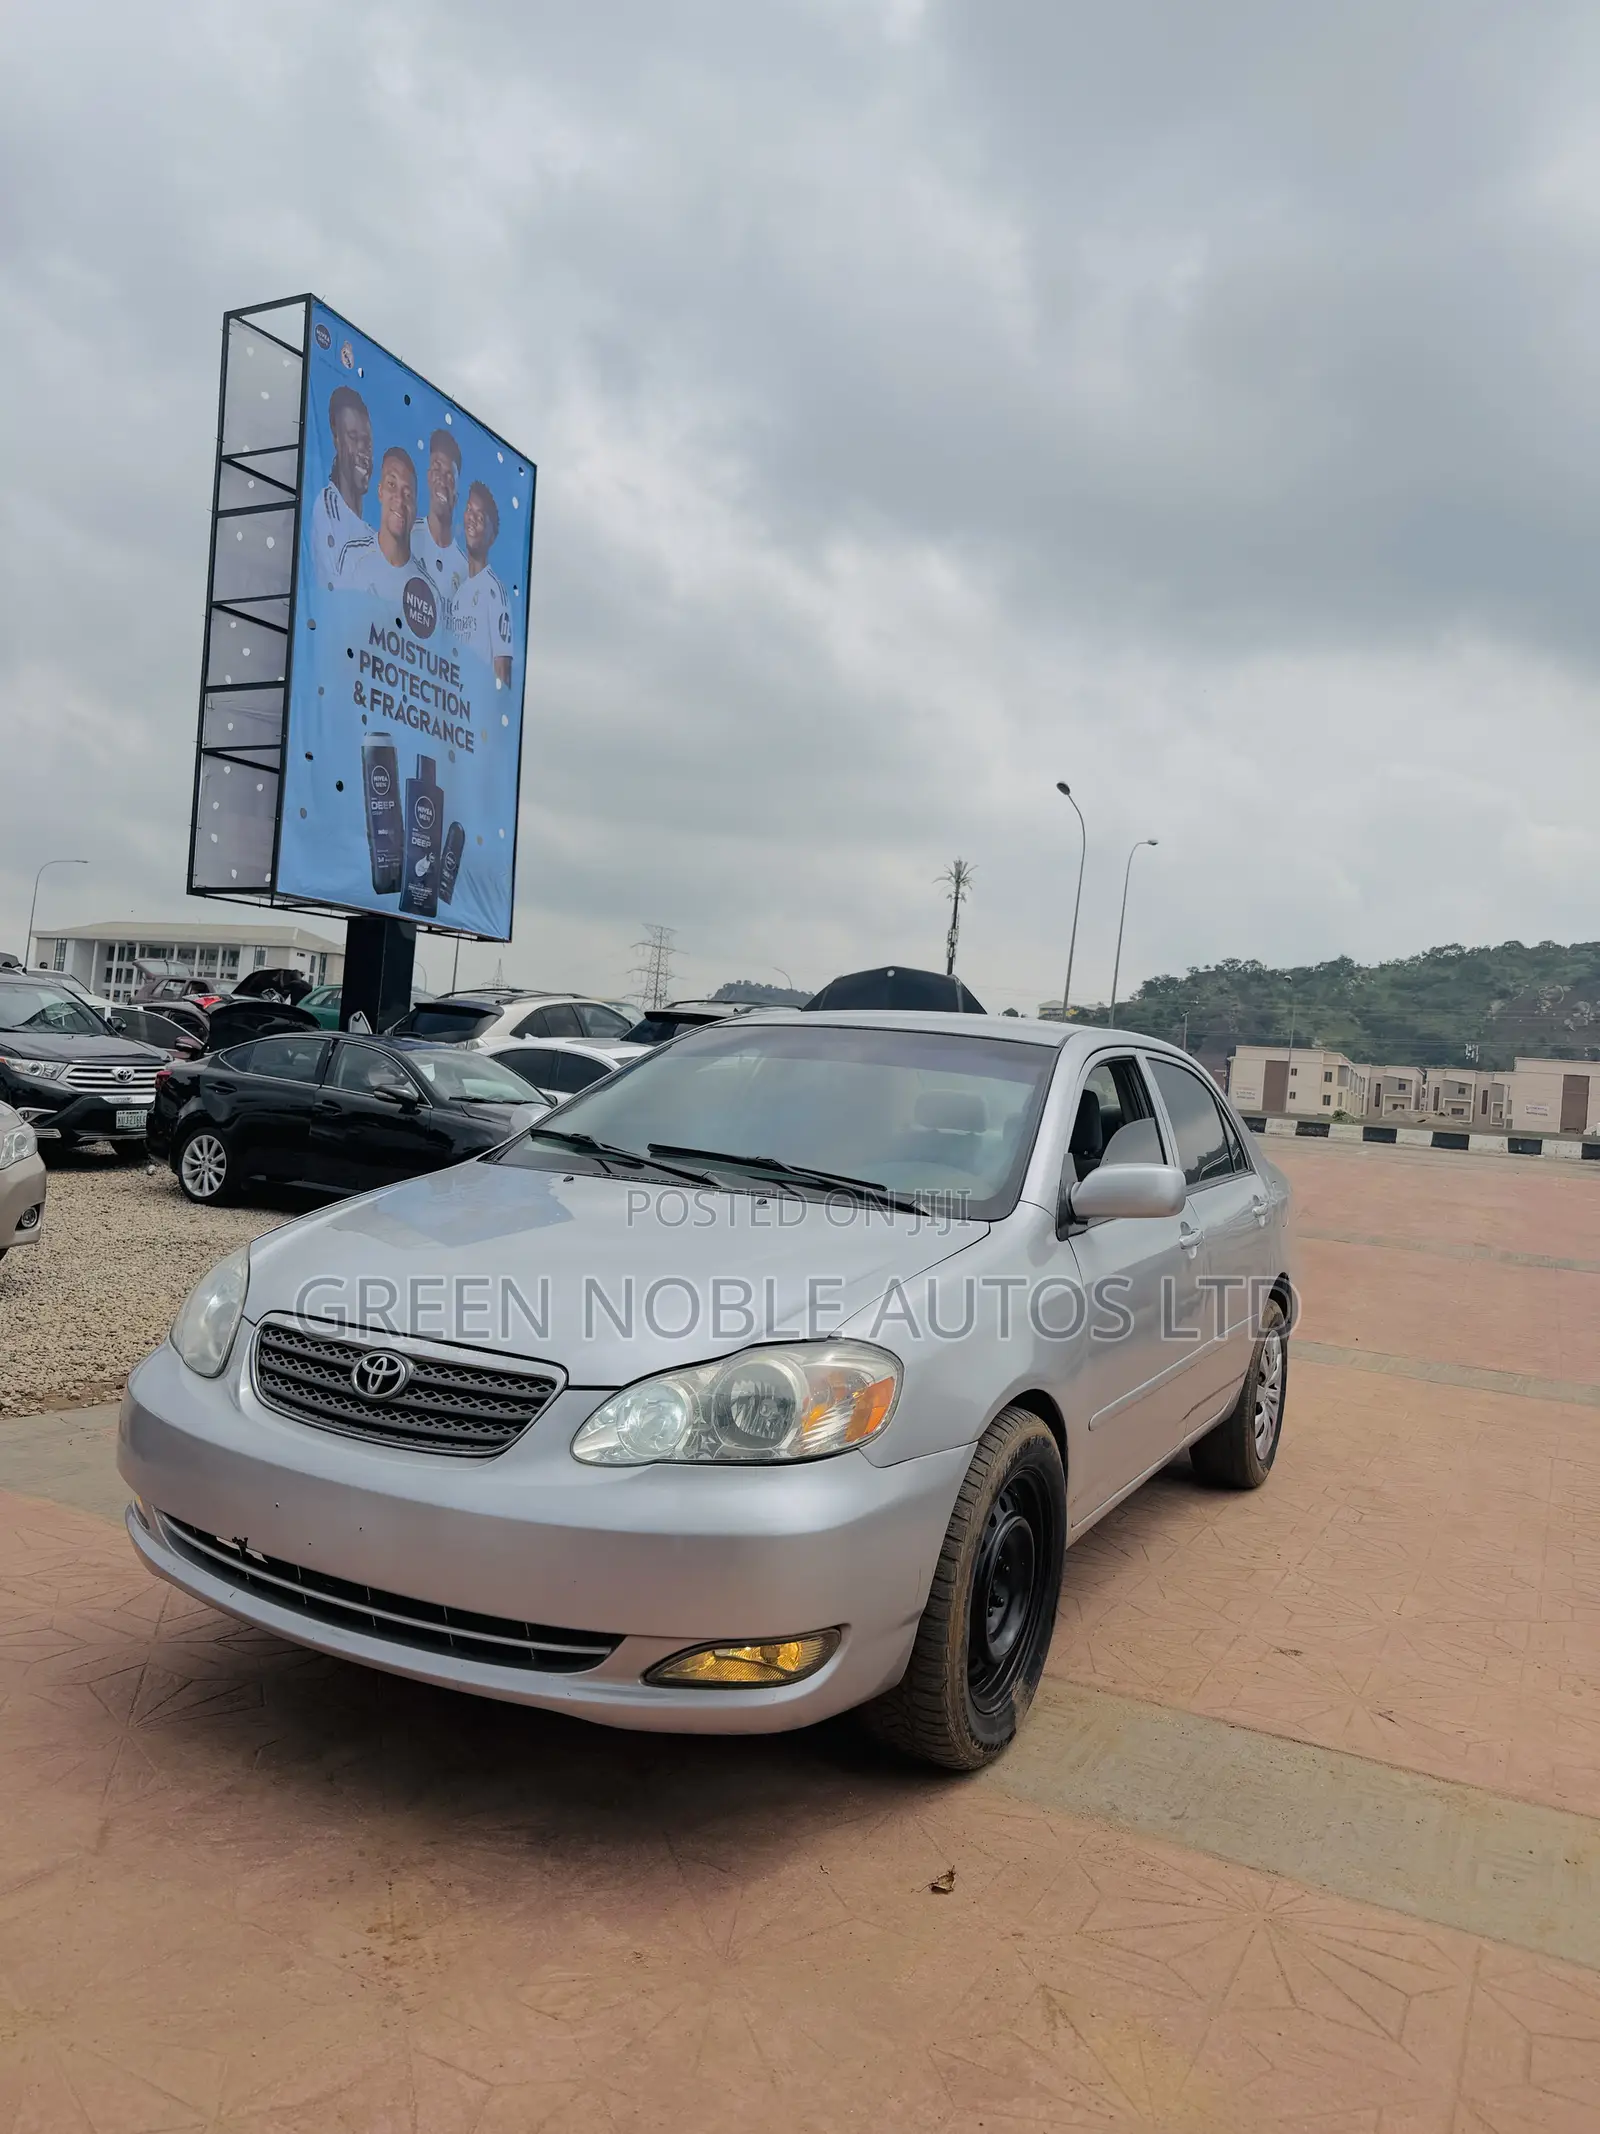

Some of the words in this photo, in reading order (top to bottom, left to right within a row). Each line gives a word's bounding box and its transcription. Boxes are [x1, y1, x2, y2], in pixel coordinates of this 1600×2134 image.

[406, 592, 434, 618] NIVEA
[409, 609, 430, 627] MEN
[368, 622, 464, 692] MOISTURE,
[360, 650, 471, 723] PROTECTION
[353, 680, 367, 708] &
[370, 688, 474, 754] FRAGRANCE
[371, 801, 395, 810] DEEP
[417, 805, 433, 816] NIVEA
[411, 836, 432, 848] DEEP
